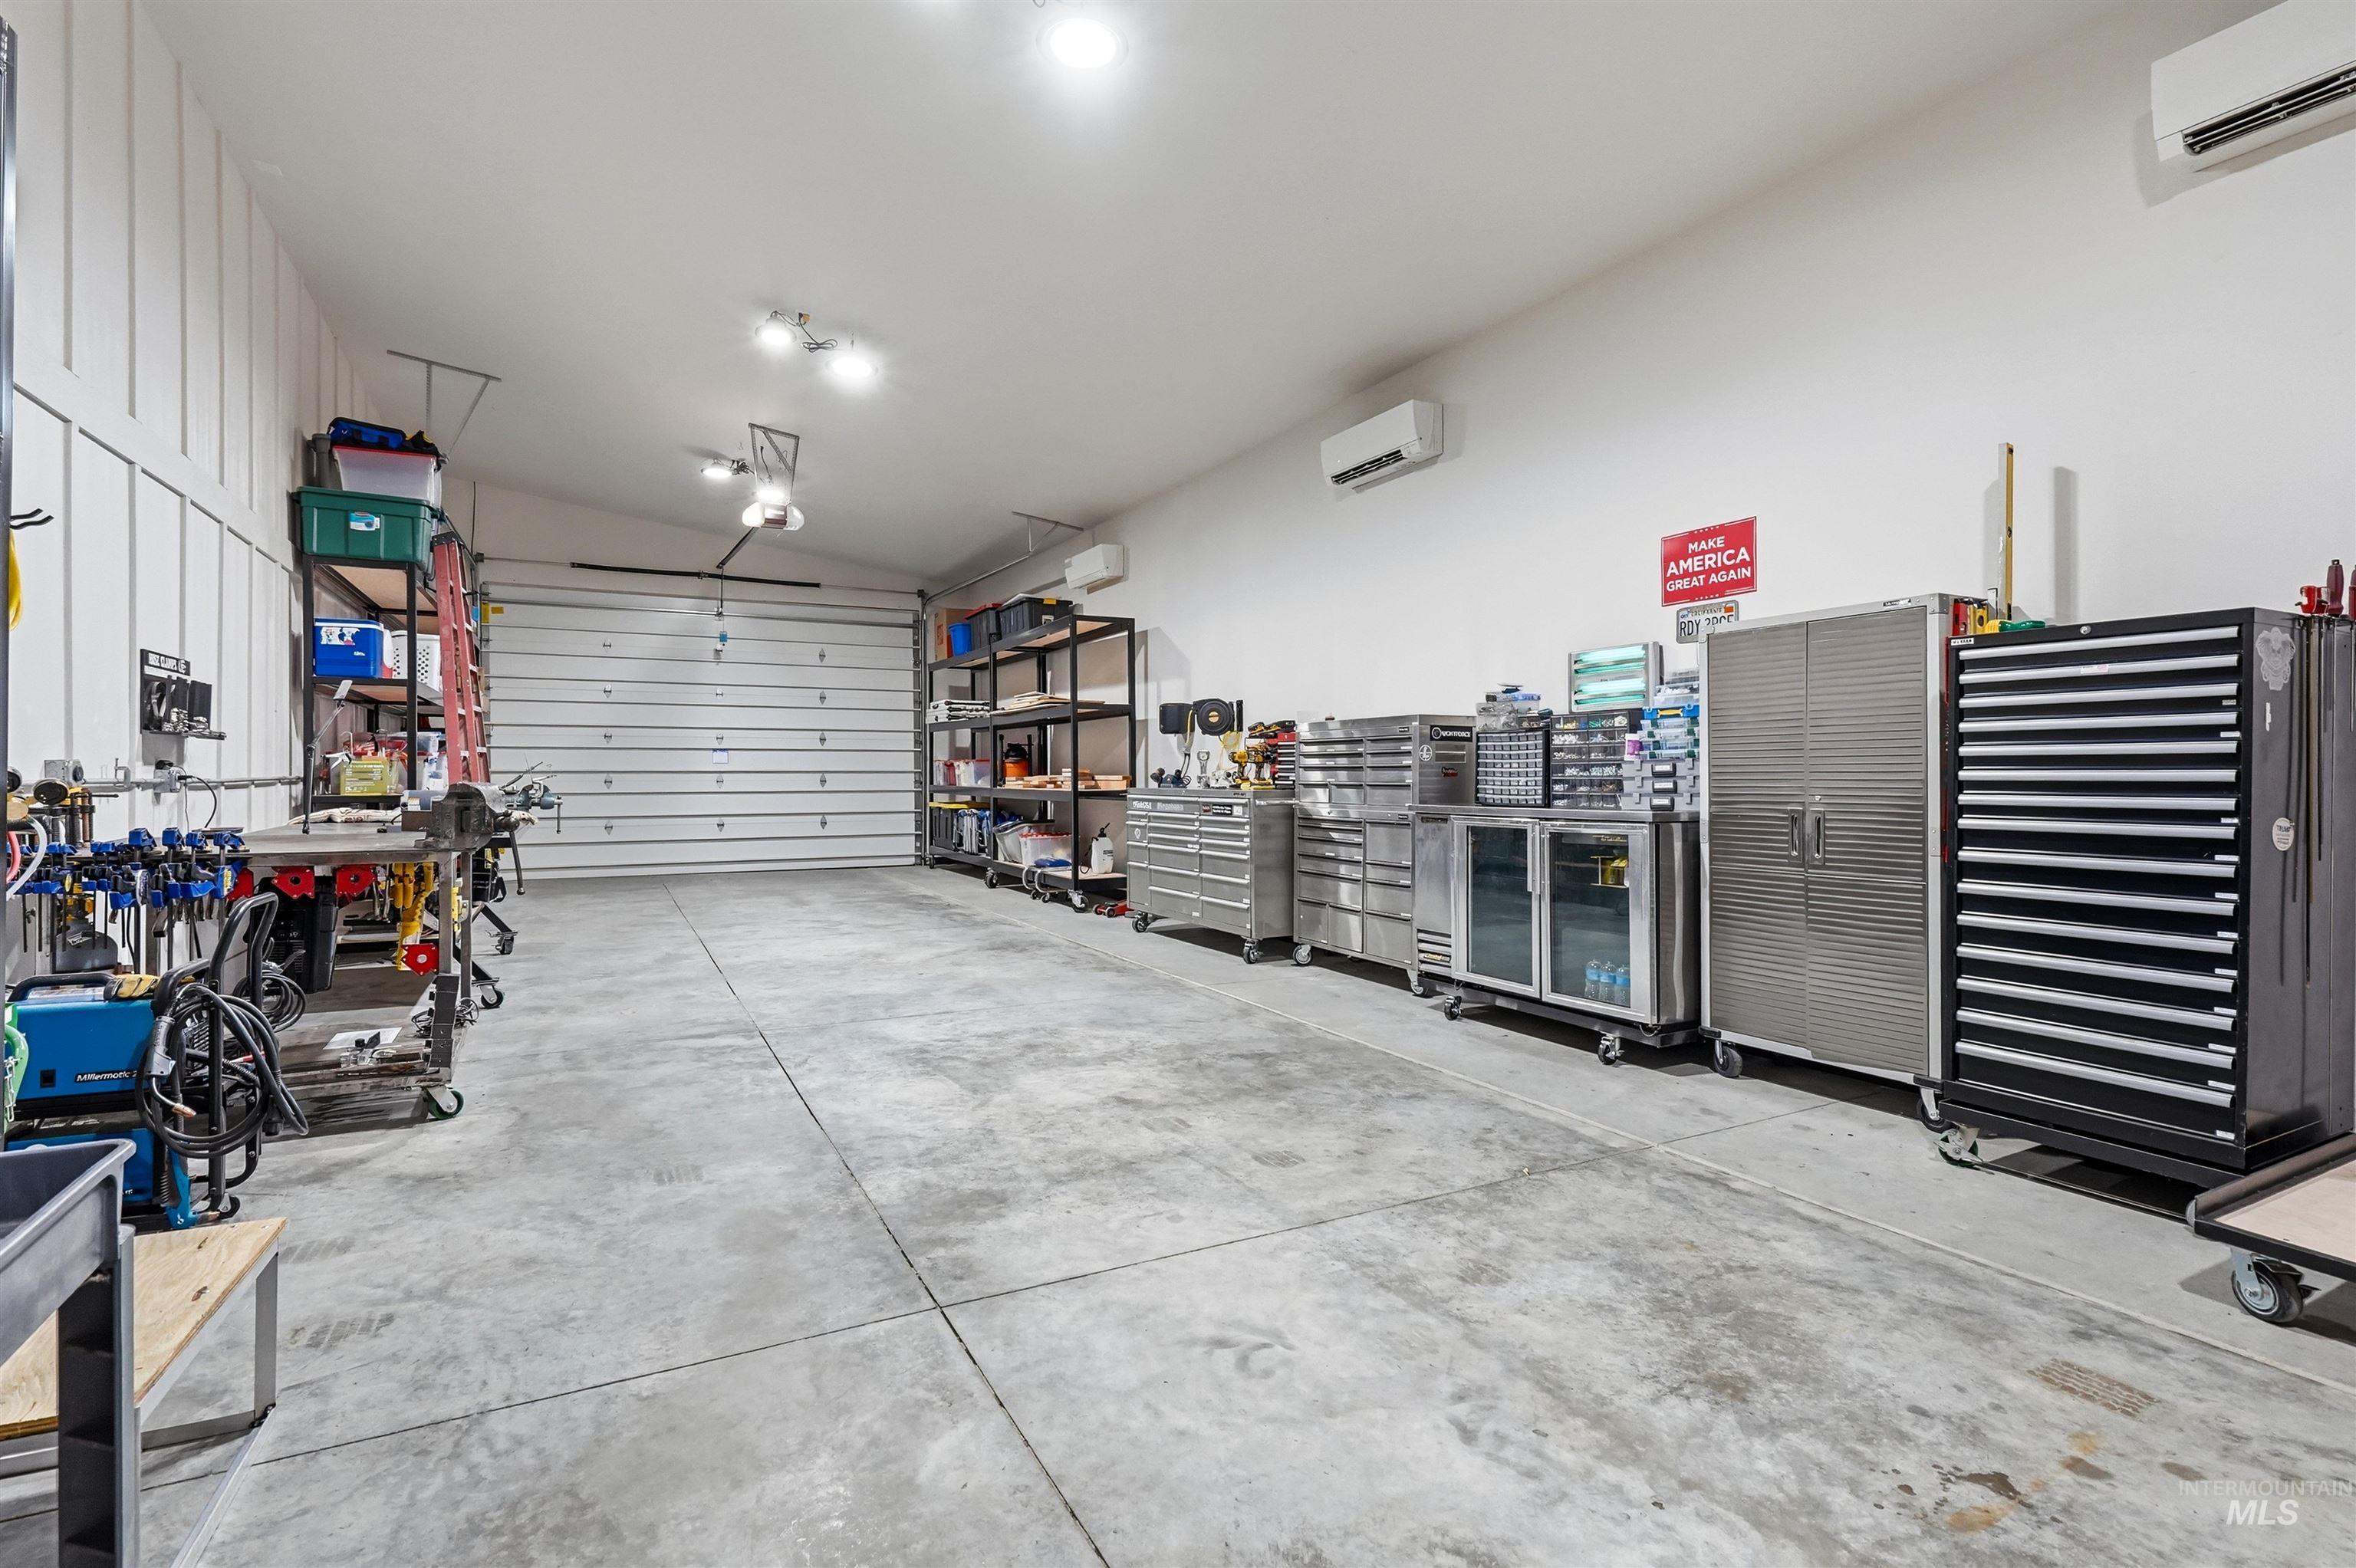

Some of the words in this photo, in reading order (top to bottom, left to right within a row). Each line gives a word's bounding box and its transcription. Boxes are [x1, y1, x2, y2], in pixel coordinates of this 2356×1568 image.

[1688, 536, 1725, 554] MAKE
[1667, 547, 1751, 577] AMERICA
[1667, 575, 1706, 592] GREAT
[1709, 566, 1752, 584] AGAIN
[1680, 619, 1701, 636] RDY
